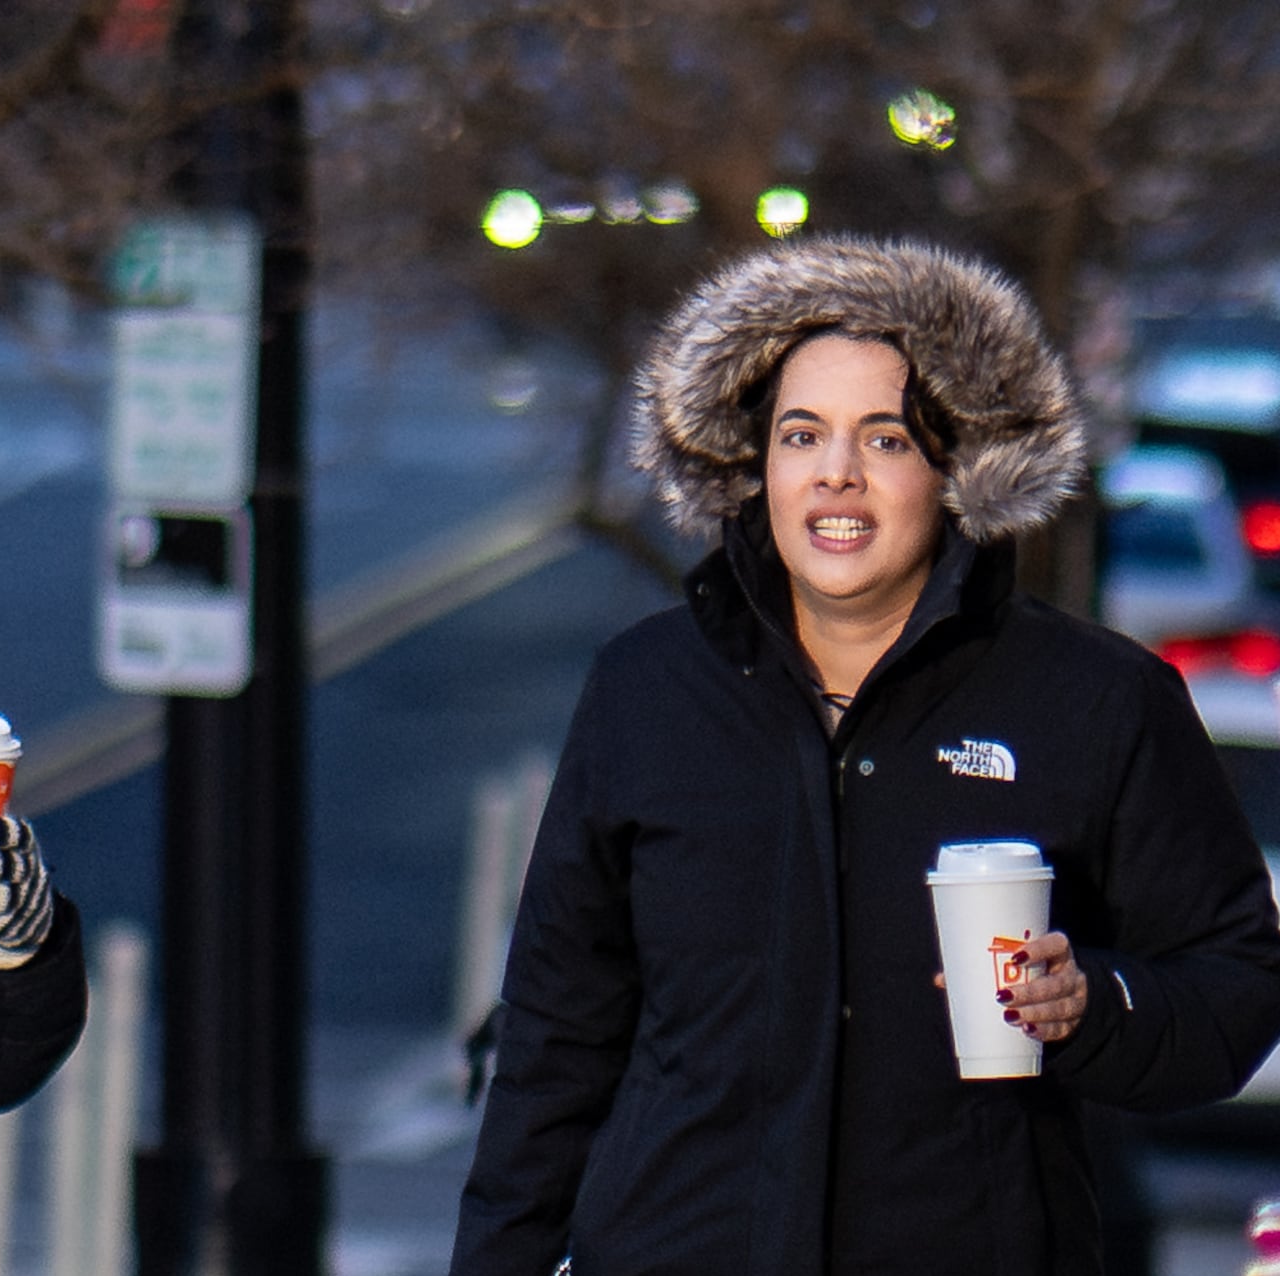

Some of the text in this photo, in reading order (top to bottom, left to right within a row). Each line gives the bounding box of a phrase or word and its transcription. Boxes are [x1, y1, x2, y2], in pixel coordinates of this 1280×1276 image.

[962, 739, 993, 755] THE
[938, 748, 991, 766] NORTH
[951, 762, 991, 778] FACE
